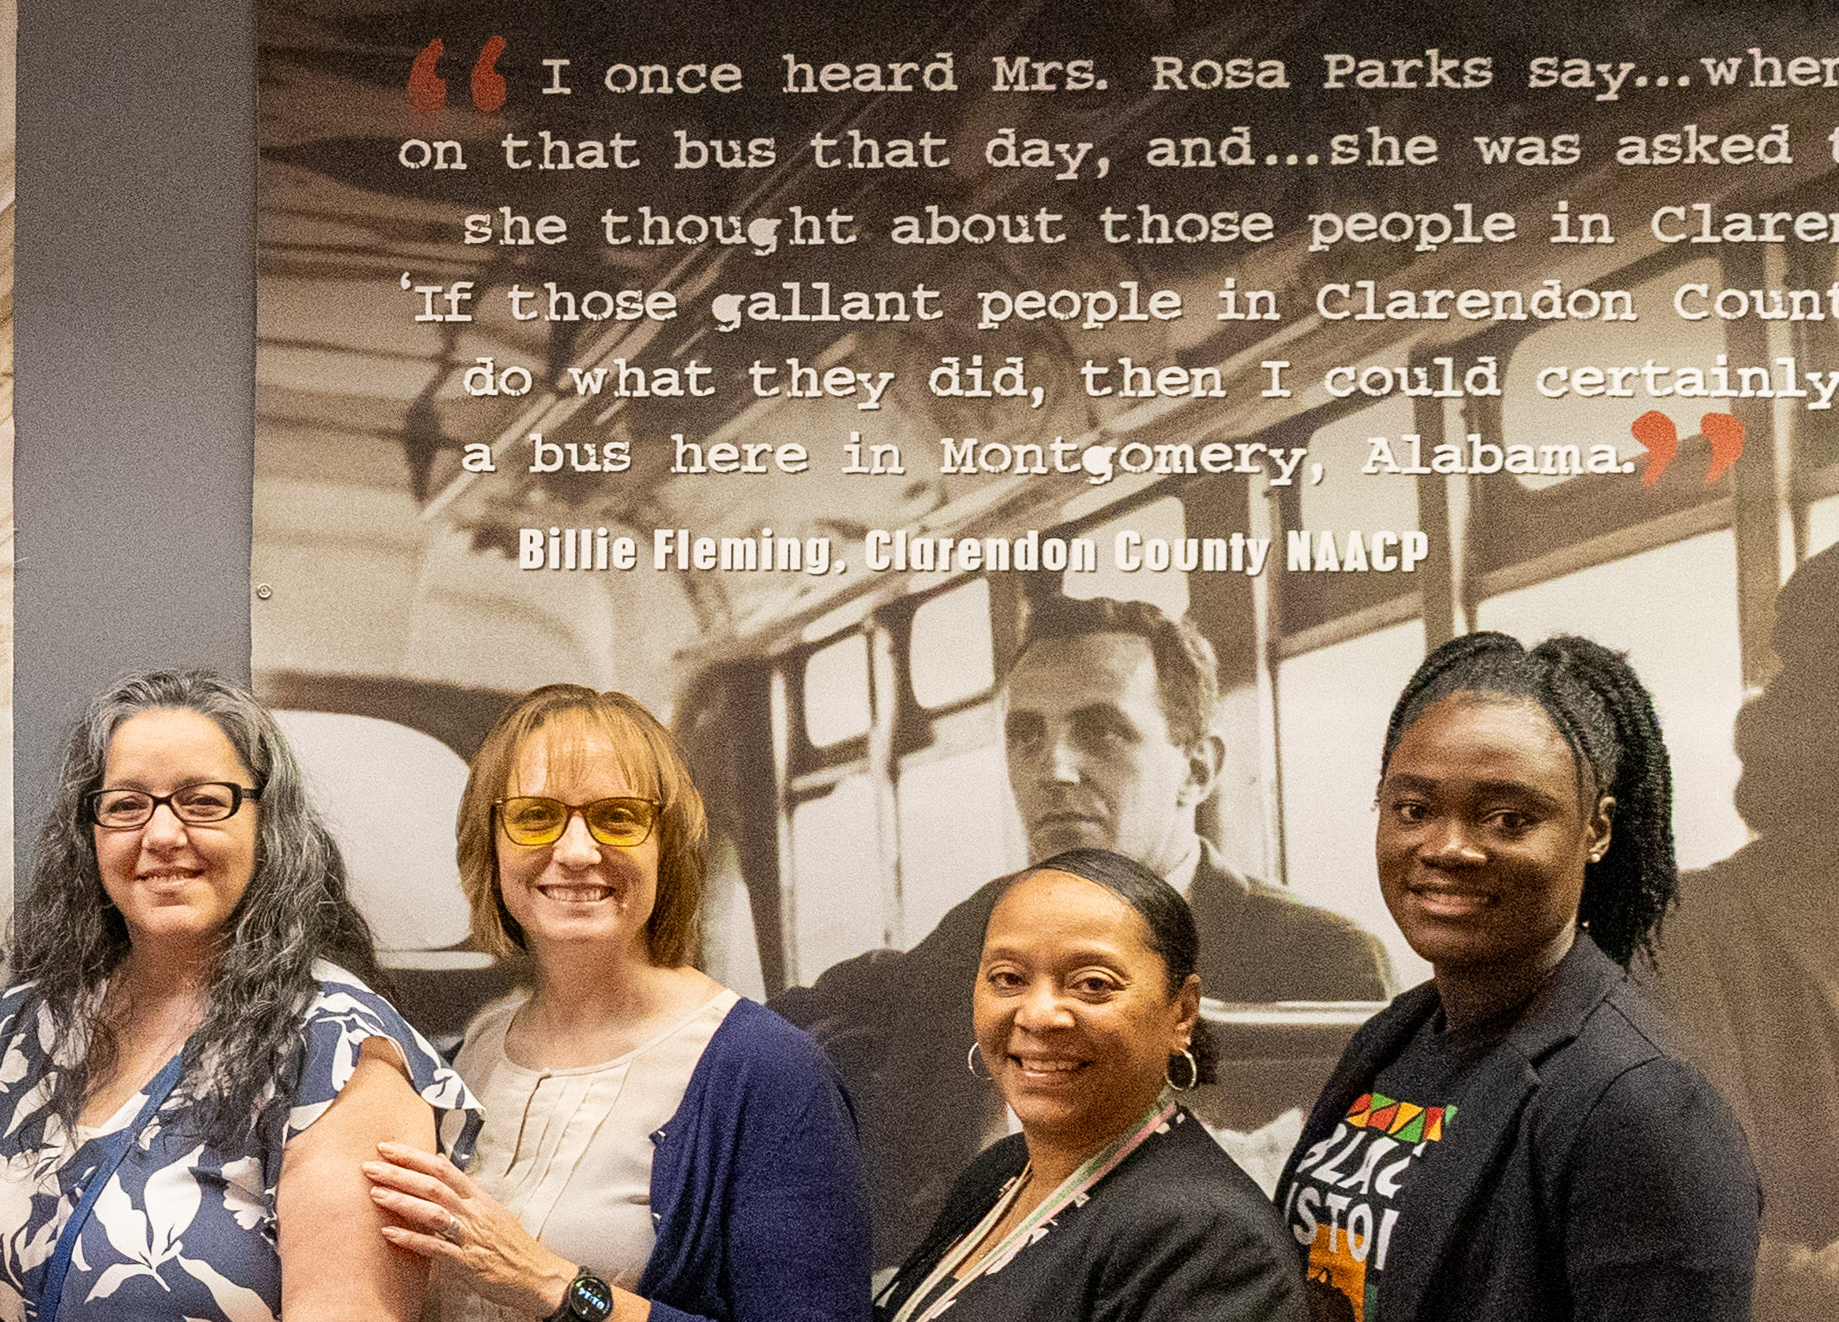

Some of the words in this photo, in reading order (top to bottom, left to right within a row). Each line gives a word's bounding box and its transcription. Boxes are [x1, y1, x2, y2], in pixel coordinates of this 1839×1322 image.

[543, 59, 571, 94] I
[605, 63, 742, 94] once
[783, 52, 957, 93] heard
[992, 56, 1107, 91] Mrs.
[1152, 56, 1289, 91] Rosa
[1324, 49, 1492, 88] Parks
[399, 139, 466, 169] on
[502, 131, 640, 170] that
[674, 130, 776, 169] bus
[810, 129, 950, 168] that
[985, 128, 1109, 180] day,
[1475, 134, 1580, 165] was
[1617, 124, 1792, 165] asked
[464, 207, 566, 245] she
[602, 206, 856, 256] thought
[892, 206, 1065, 244] about
[1100, 204, 1273, 244] those
[1308, 204, 1516, 252] people
[1551, 201, 1614, 243] in
[1651, 202, 1839, 242] Clare
[507, 283, 678, 323] those
[712, 282, 943, 332] gallant
[978, 281, 1184, 329] people
[1216, 279, 1281, 320] in
[1316, 279, 1637, 320] Clarendon
[463, 357, 532, 399] do
[569, 357, 716, 399] what
[749, 357, 891, 409] they
[929, 356, 1043, 407] did,
[1080, 356, 1226, 398] then
[1262, 361, 1290, 397] I
[1324, 355, 1500, 397] could
[1536, 353, 1839, 409] certainly
[461, 442, 496, 475] a
[529, 433, 631, 474] bus
[669, 433, 809, 474] here
[842, 431, 905, 473] in
[940, 434, 1325, 486] Montgomery,
[518, 527, 638, 570] Billie
[653, 528, 847, 580] Fleming,
[865, 529, 1098, 572] Clarendon
[1116, 530, 1271, 580] County
[1288, 530, 1429, 572] NAACP
[1296, 1123, 1426, 1199] BLAC
